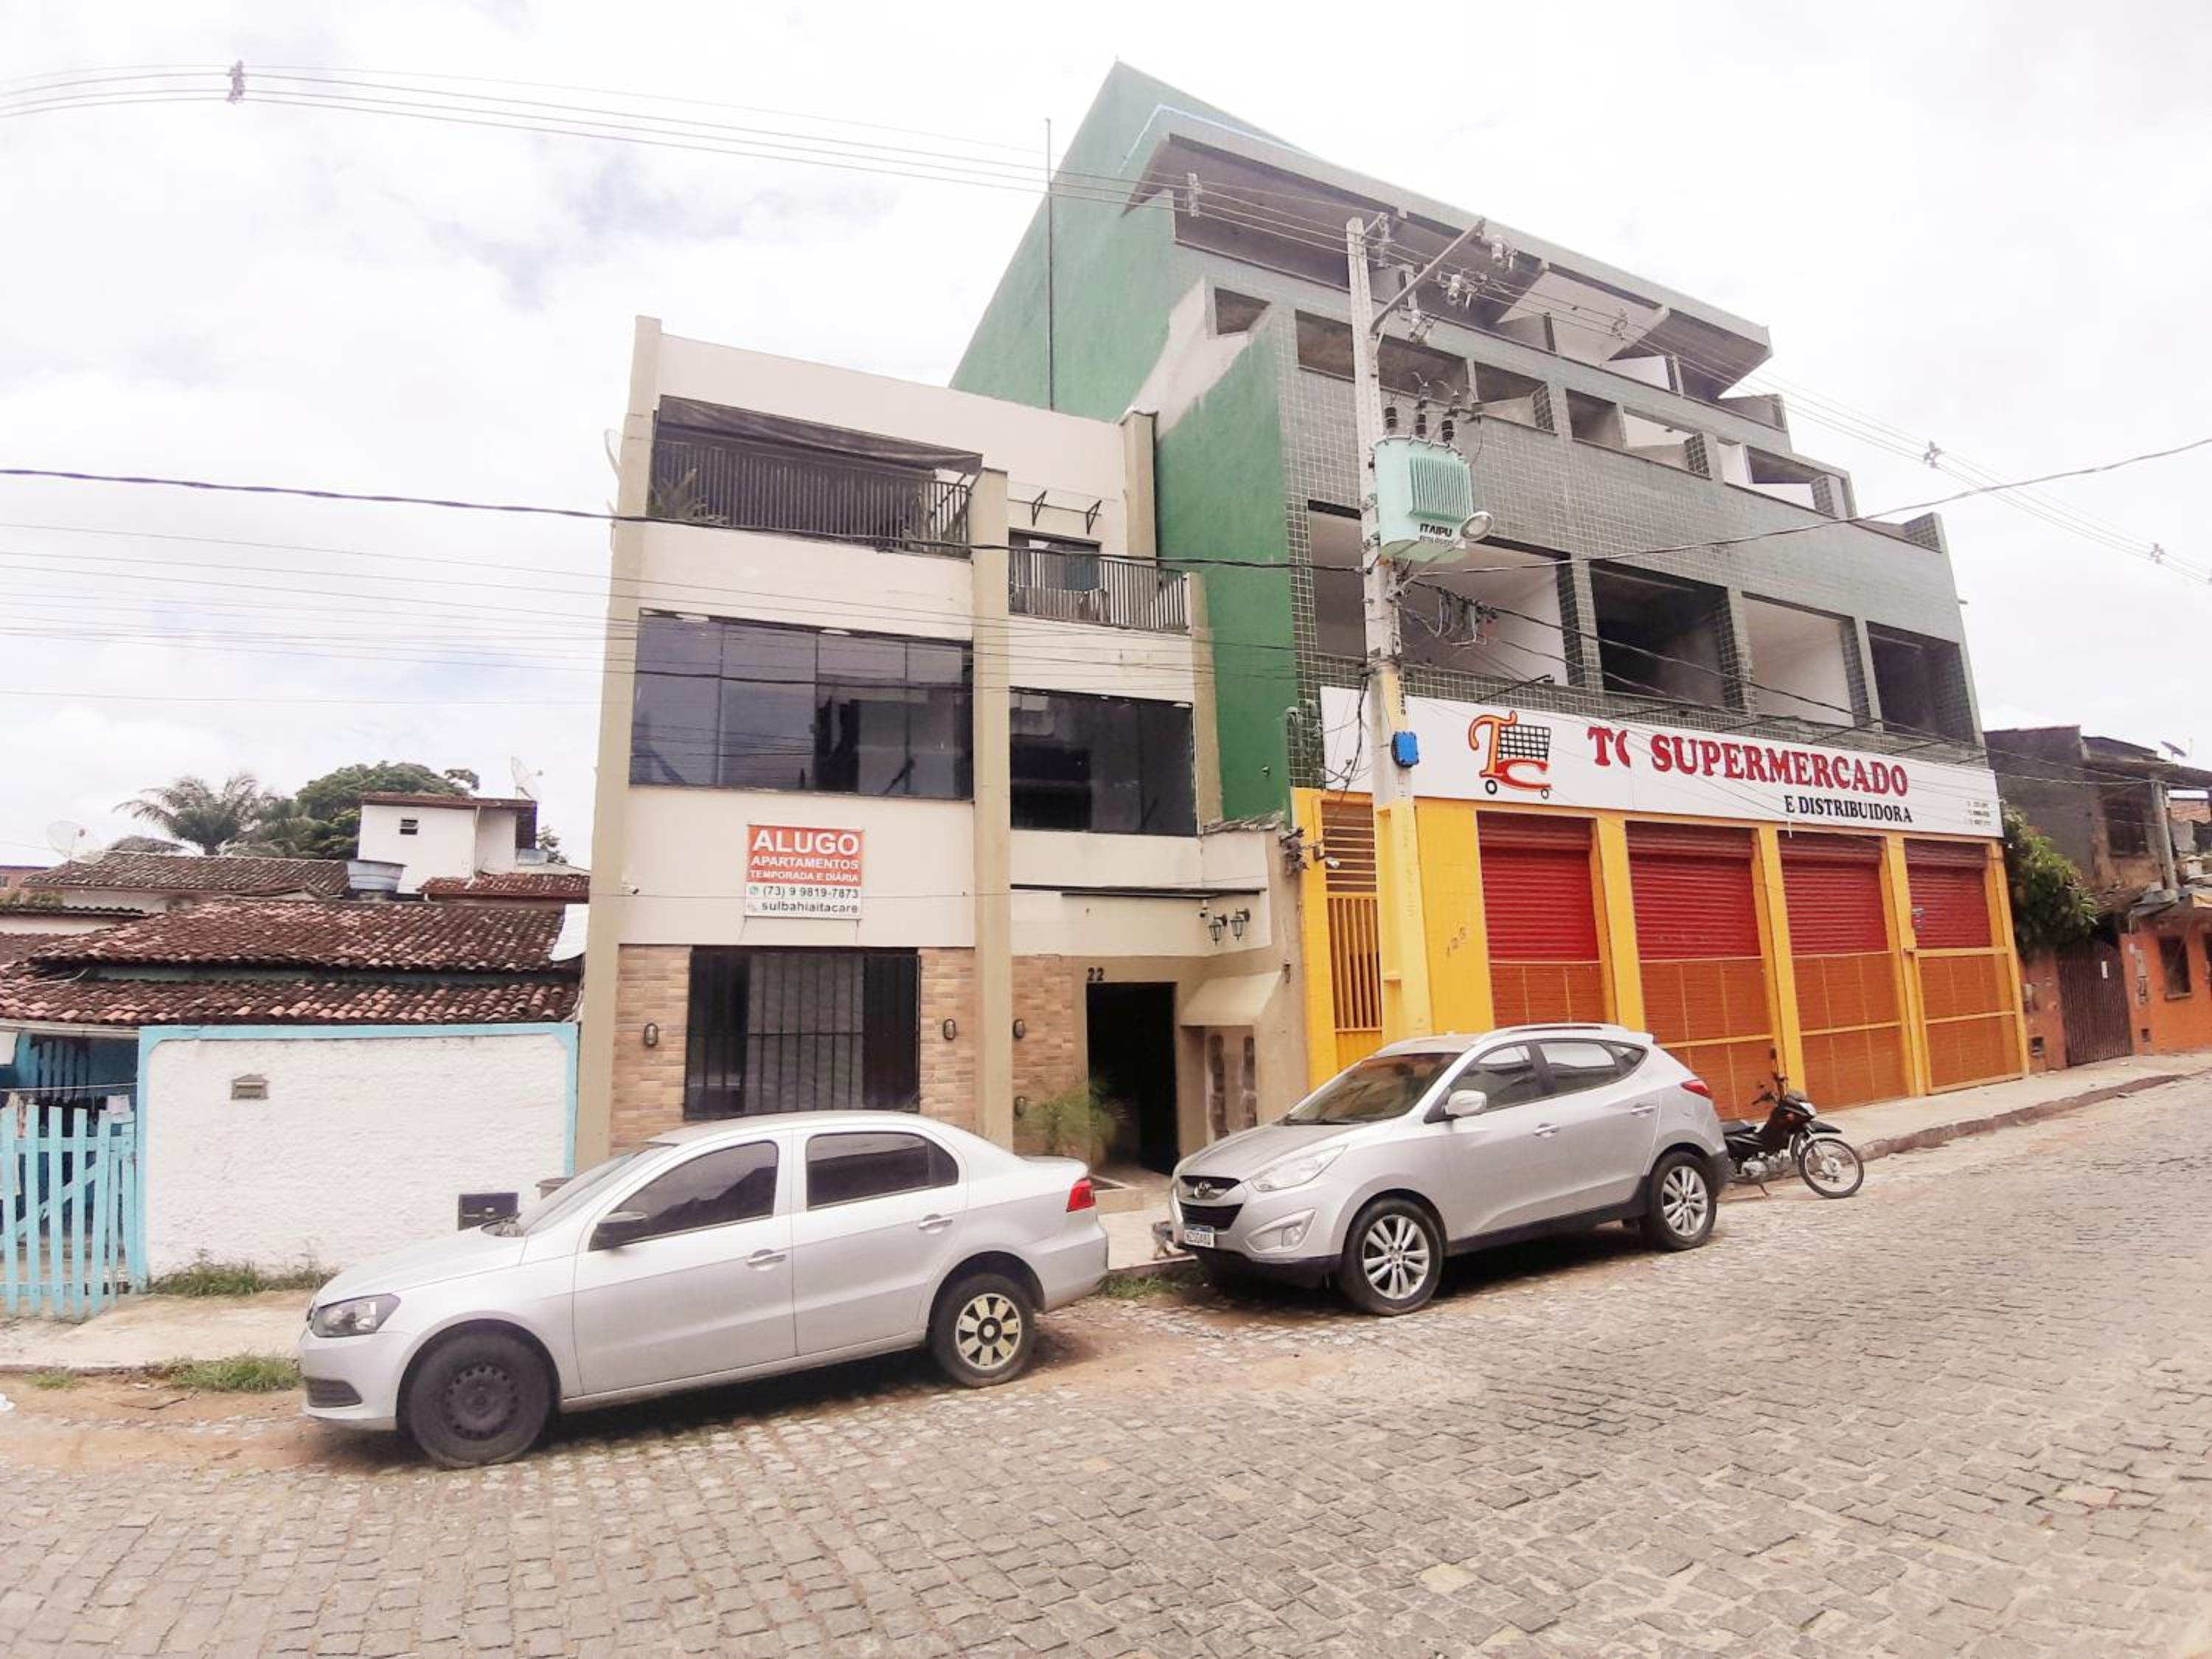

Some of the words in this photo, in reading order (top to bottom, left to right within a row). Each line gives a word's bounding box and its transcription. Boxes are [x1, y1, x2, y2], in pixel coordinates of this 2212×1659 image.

[1420, 523, 1453, 537] ITAIPU
[1651, 734, 1908, 797] SUPERMERCADO
[1784, 795, 1795, 813] E
[1798, 796, 1913, 823] DISTRIBUIDORA
[754, 830, 859, 855] ALUGO
[751, 857, 859, 869] APARTAMENTOS
[749, 870, 814, 880] TEMPORADA
[816, 872, 824, 881] E
[763, 886, 785, 898] (73)
[789, 887, 796, 896] 9
[799, 888, 858, 899] 9819-7873
[762, 901, 858, 913] sulbahiaitacare
[1087, 967, 1104, 981] 22
